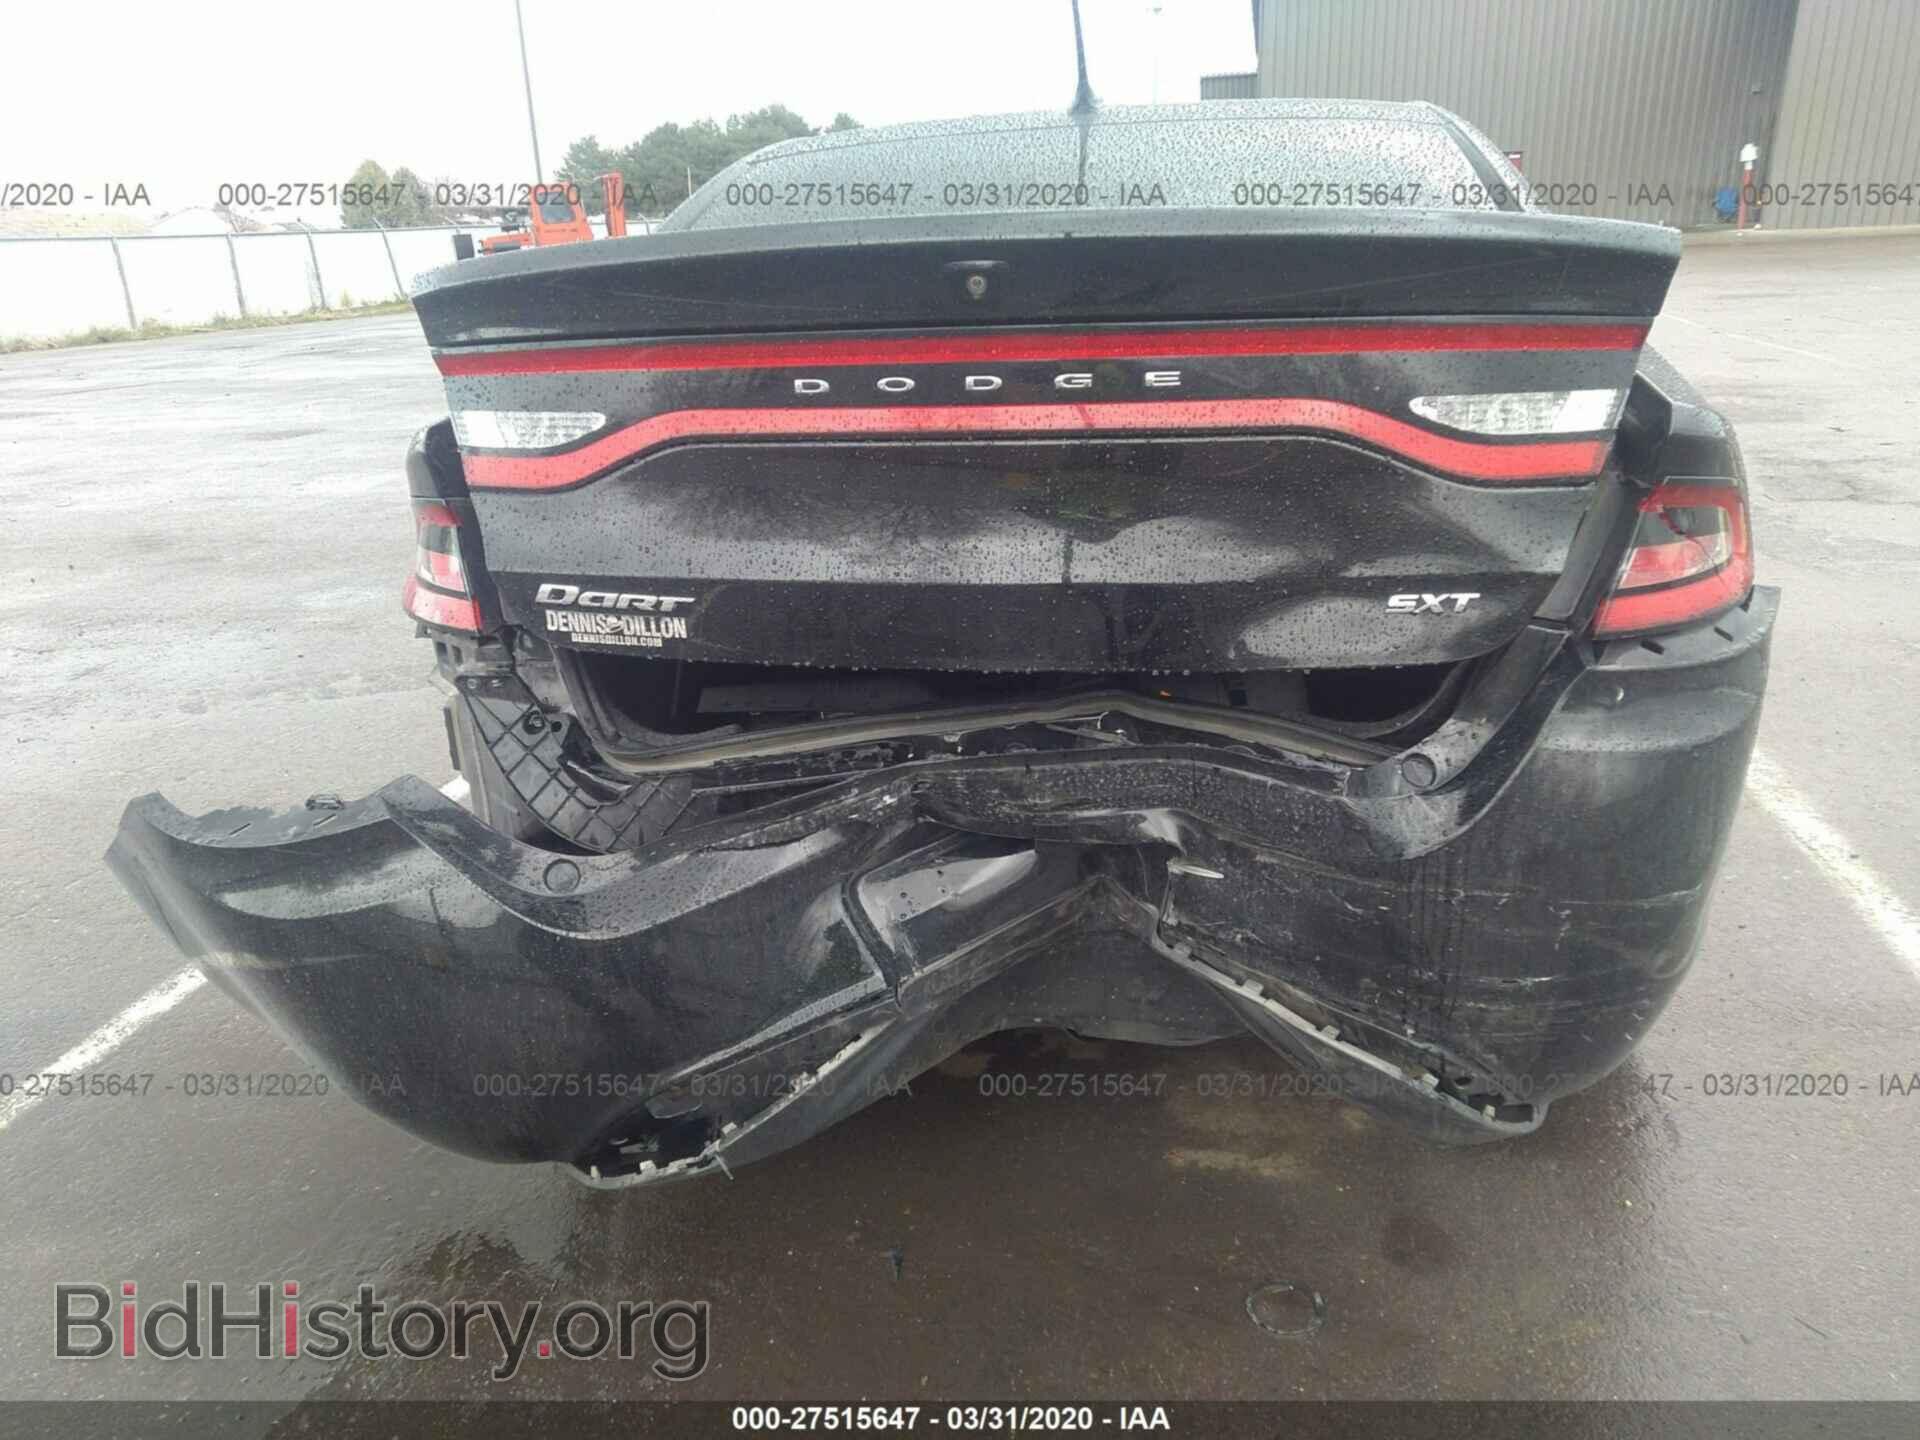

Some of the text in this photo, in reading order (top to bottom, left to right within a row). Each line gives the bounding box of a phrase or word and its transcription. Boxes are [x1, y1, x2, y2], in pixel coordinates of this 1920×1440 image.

[794, 371, 1182, 393] DODGE
[1385, 593, 1480, 613] SXT
[545, 609, 688, 638] DENNIS DILLON
[571, 632, 662, 647] DENNISDILLON.COM
